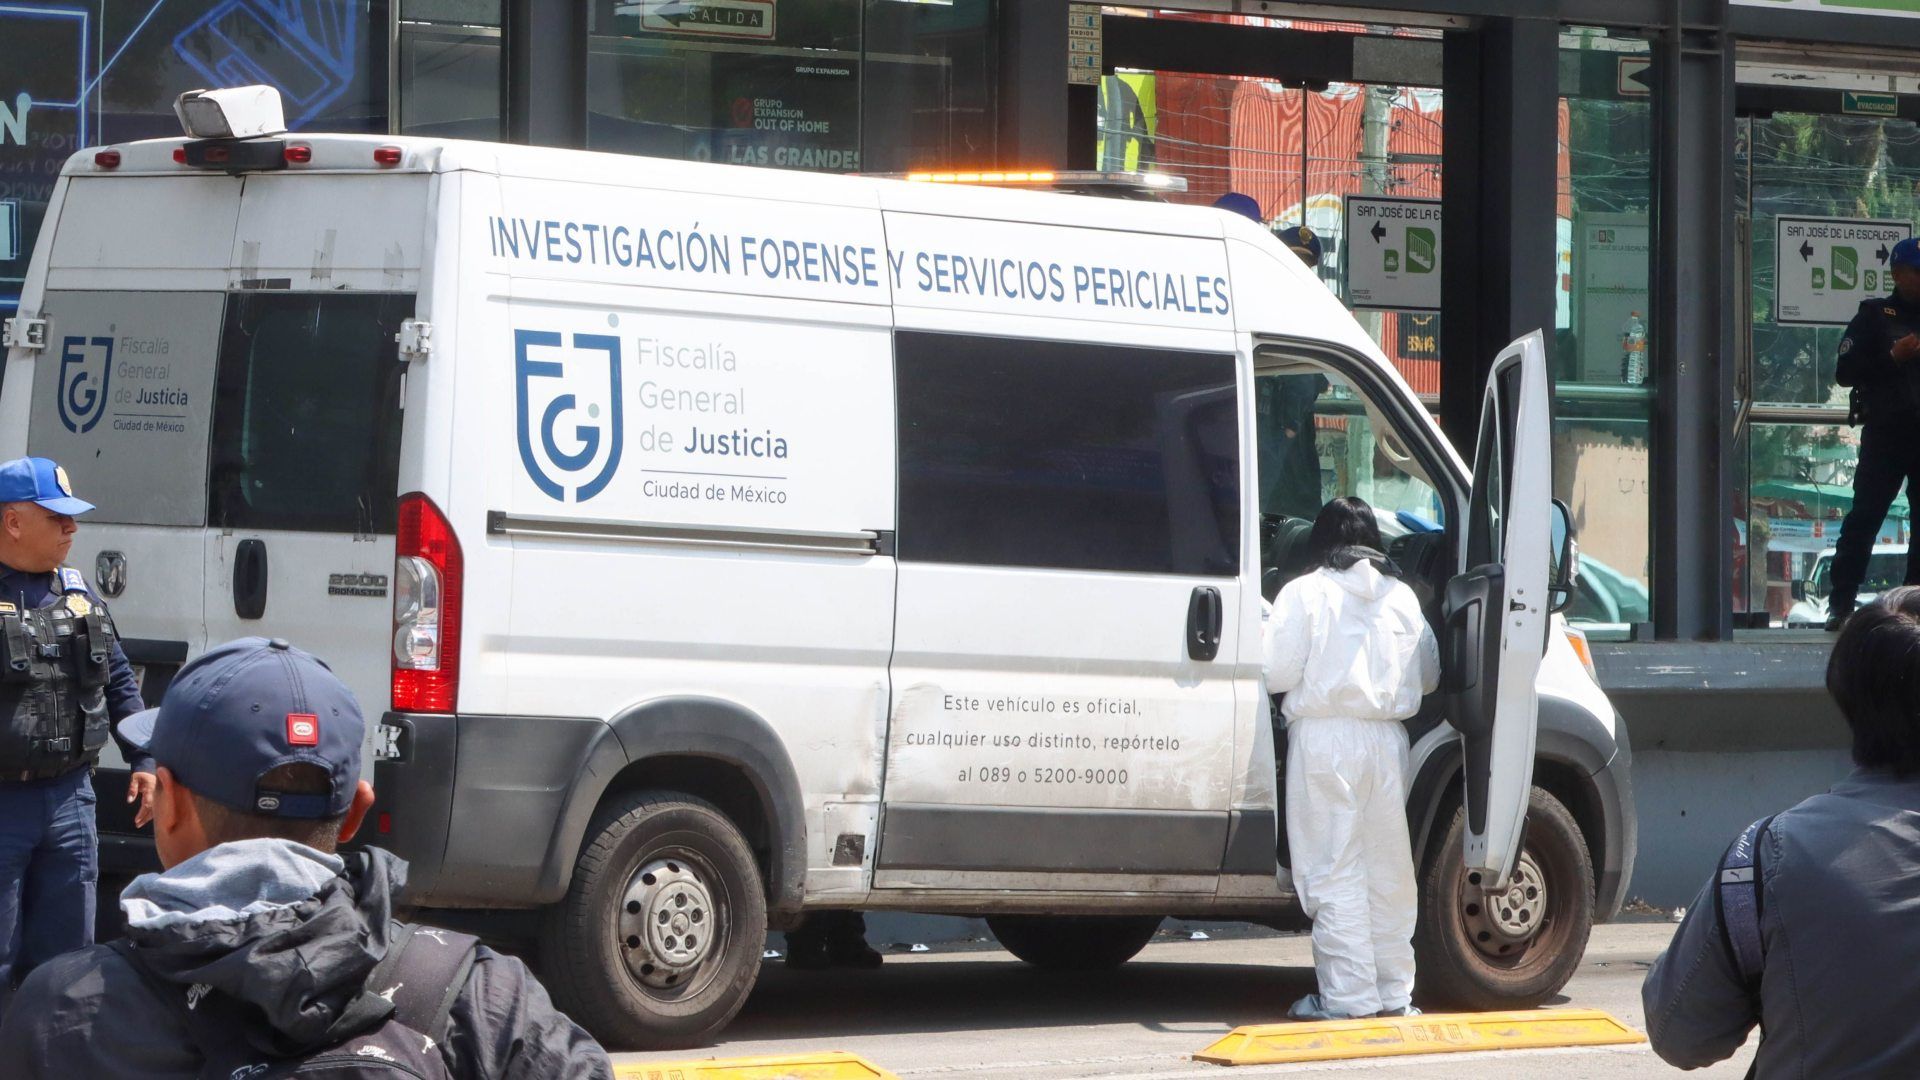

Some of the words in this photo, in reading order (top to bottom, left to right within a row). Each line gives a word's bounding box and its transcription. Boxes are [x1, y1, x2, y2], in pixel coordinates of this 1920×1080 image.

[689, 8, 758, 25] SALIDA
[795, 66, 815, 74] GRUPO
[754, 98, 783, 108] GRUPO
[754, 108, 804, 119] EXPANSION
[754, 118, 777, 131] OUT
[779, 119, 794, 132] OF
[796, 120, 830, 134] HOME
[730, 144, 769, 165] LAS
[1357, 205, 1377, 217] SAN
[1379, 204, 1403, 219] JOSÉ
[1405, 208, 1418, 220] DE
[1420, 209, 1432, 220] LA
[1787, 226, 1804, 237] SAN
[1806, 225, 1829, 238] JOSÉ
[1830, 228, 1842, 239] DE
[1843, 229, 1855, 240] LA
[1856, 229, 1900, 241] ESCALERA
[489, 216, 731, 275] INVESTIGACIÓN
[740, 236, 879, 287] FORENSE
[886, 250, 905, 289] Y
[916, 251, 1065, 302] SERVICIOS
[1073, 265, 1230, 316] PERICIALES
[119, 336, 169, 355] Fiscalía
[637, 337, 737, 372] Fiscalía
[117, 361, 170, 380] General
[115, 387, 132, 405] de
[135, 388, 188, 406] Justicia
[638, 380, 745, 415] General
[113, 419, 141, 431] Ciudad
[143, 420, 154, 432] de
[156, 421, 185, 433] México
[639, 424, 674, 453] de
[683, 426, 788, 459] Justicia
[642, 480, 700, 500] Ciudad
[705, 481, 725, 501] de
[730, 485, 787, 504] México
[329, 574, 388, 586] 2500
[944, 695, 980, 711] Este
[986, 697, 1056, 713] vehículo
[1062, 700, 1080, 713] es
[1087, 698, 1142, 717] oficial,
[906, 730, 986, 749] cualquier
[993, 734, 1021, 747] uso
[1028, 732, 1097, 751] distinto,
[1103, 734, 1180, 752] repórtelo
[958, 766, 972, 782] al
[979, 766, 1011, 783] 089
[1017, 770, 1027, 783] o
[1034, 767, 1129, 784] 5200-9000
